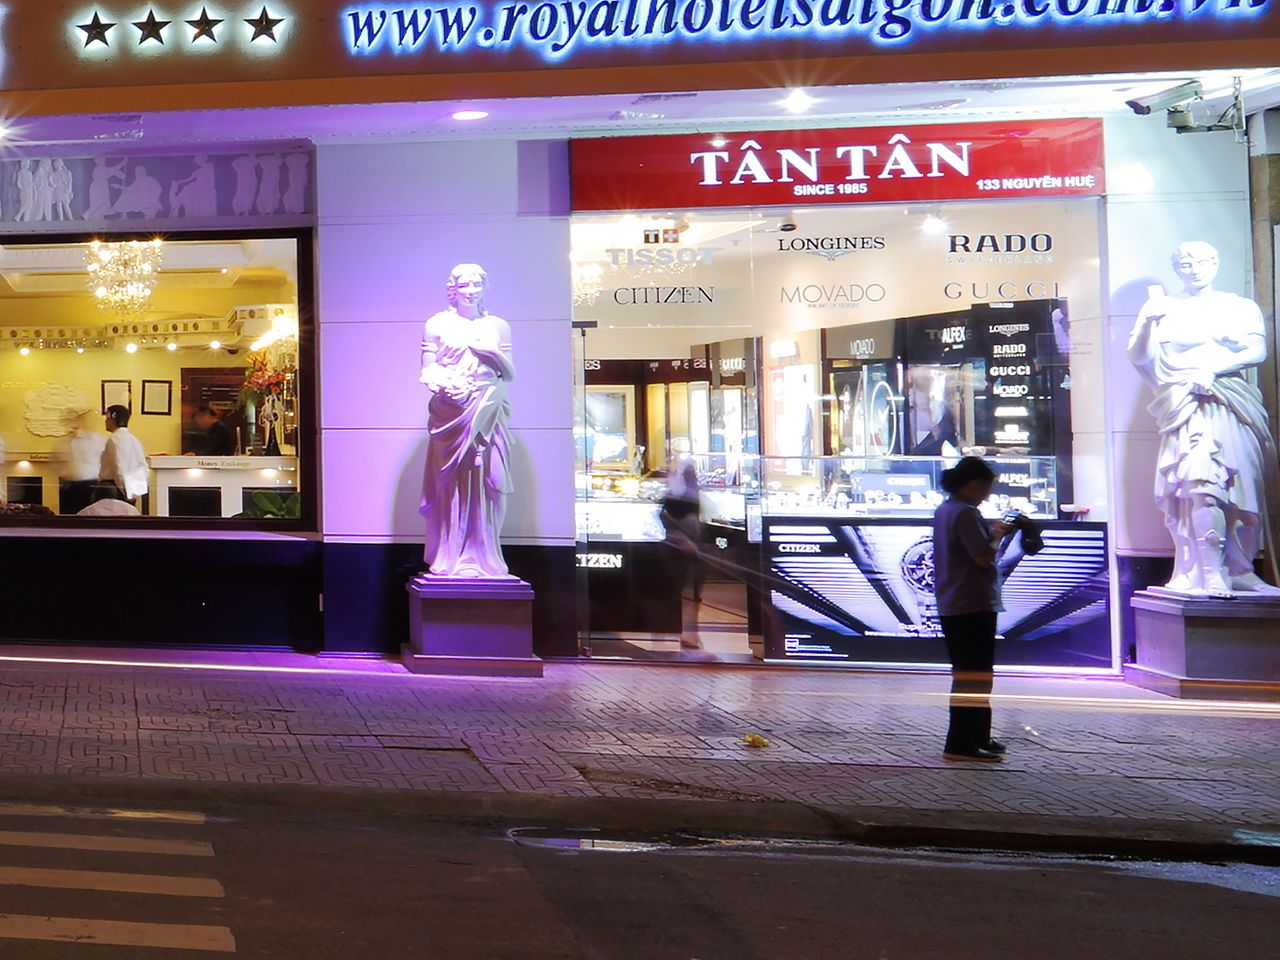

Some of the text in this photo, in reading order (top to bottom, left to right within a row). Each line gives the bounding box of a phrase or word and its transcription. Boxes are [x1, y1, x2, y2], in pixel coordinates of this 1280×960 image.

[690, 133, 973, 186] TÂN TÂN
[793, 182, 868, 196] SINCE 1985
[976, 179, 1000, 190] 133
[778, 236, 886, 251] LONGINES
[947, 233, 1053, 253] RADO
[605, 247, 723, 266] TISSOT
[613, 286, 716, 305] CITIZEN
[780, 283, 886, 303] MOVADO
[944, 281, 1060, 300] GUCCI
[941, 326, 966, 343] ALFEX
[989, 323, 1030, 333] LONGINES
[993, 343, 1027, 354] RADO
[989, 365, 1031, 376] GUCCI
[778, 543, 822, 553] CITIZEN
